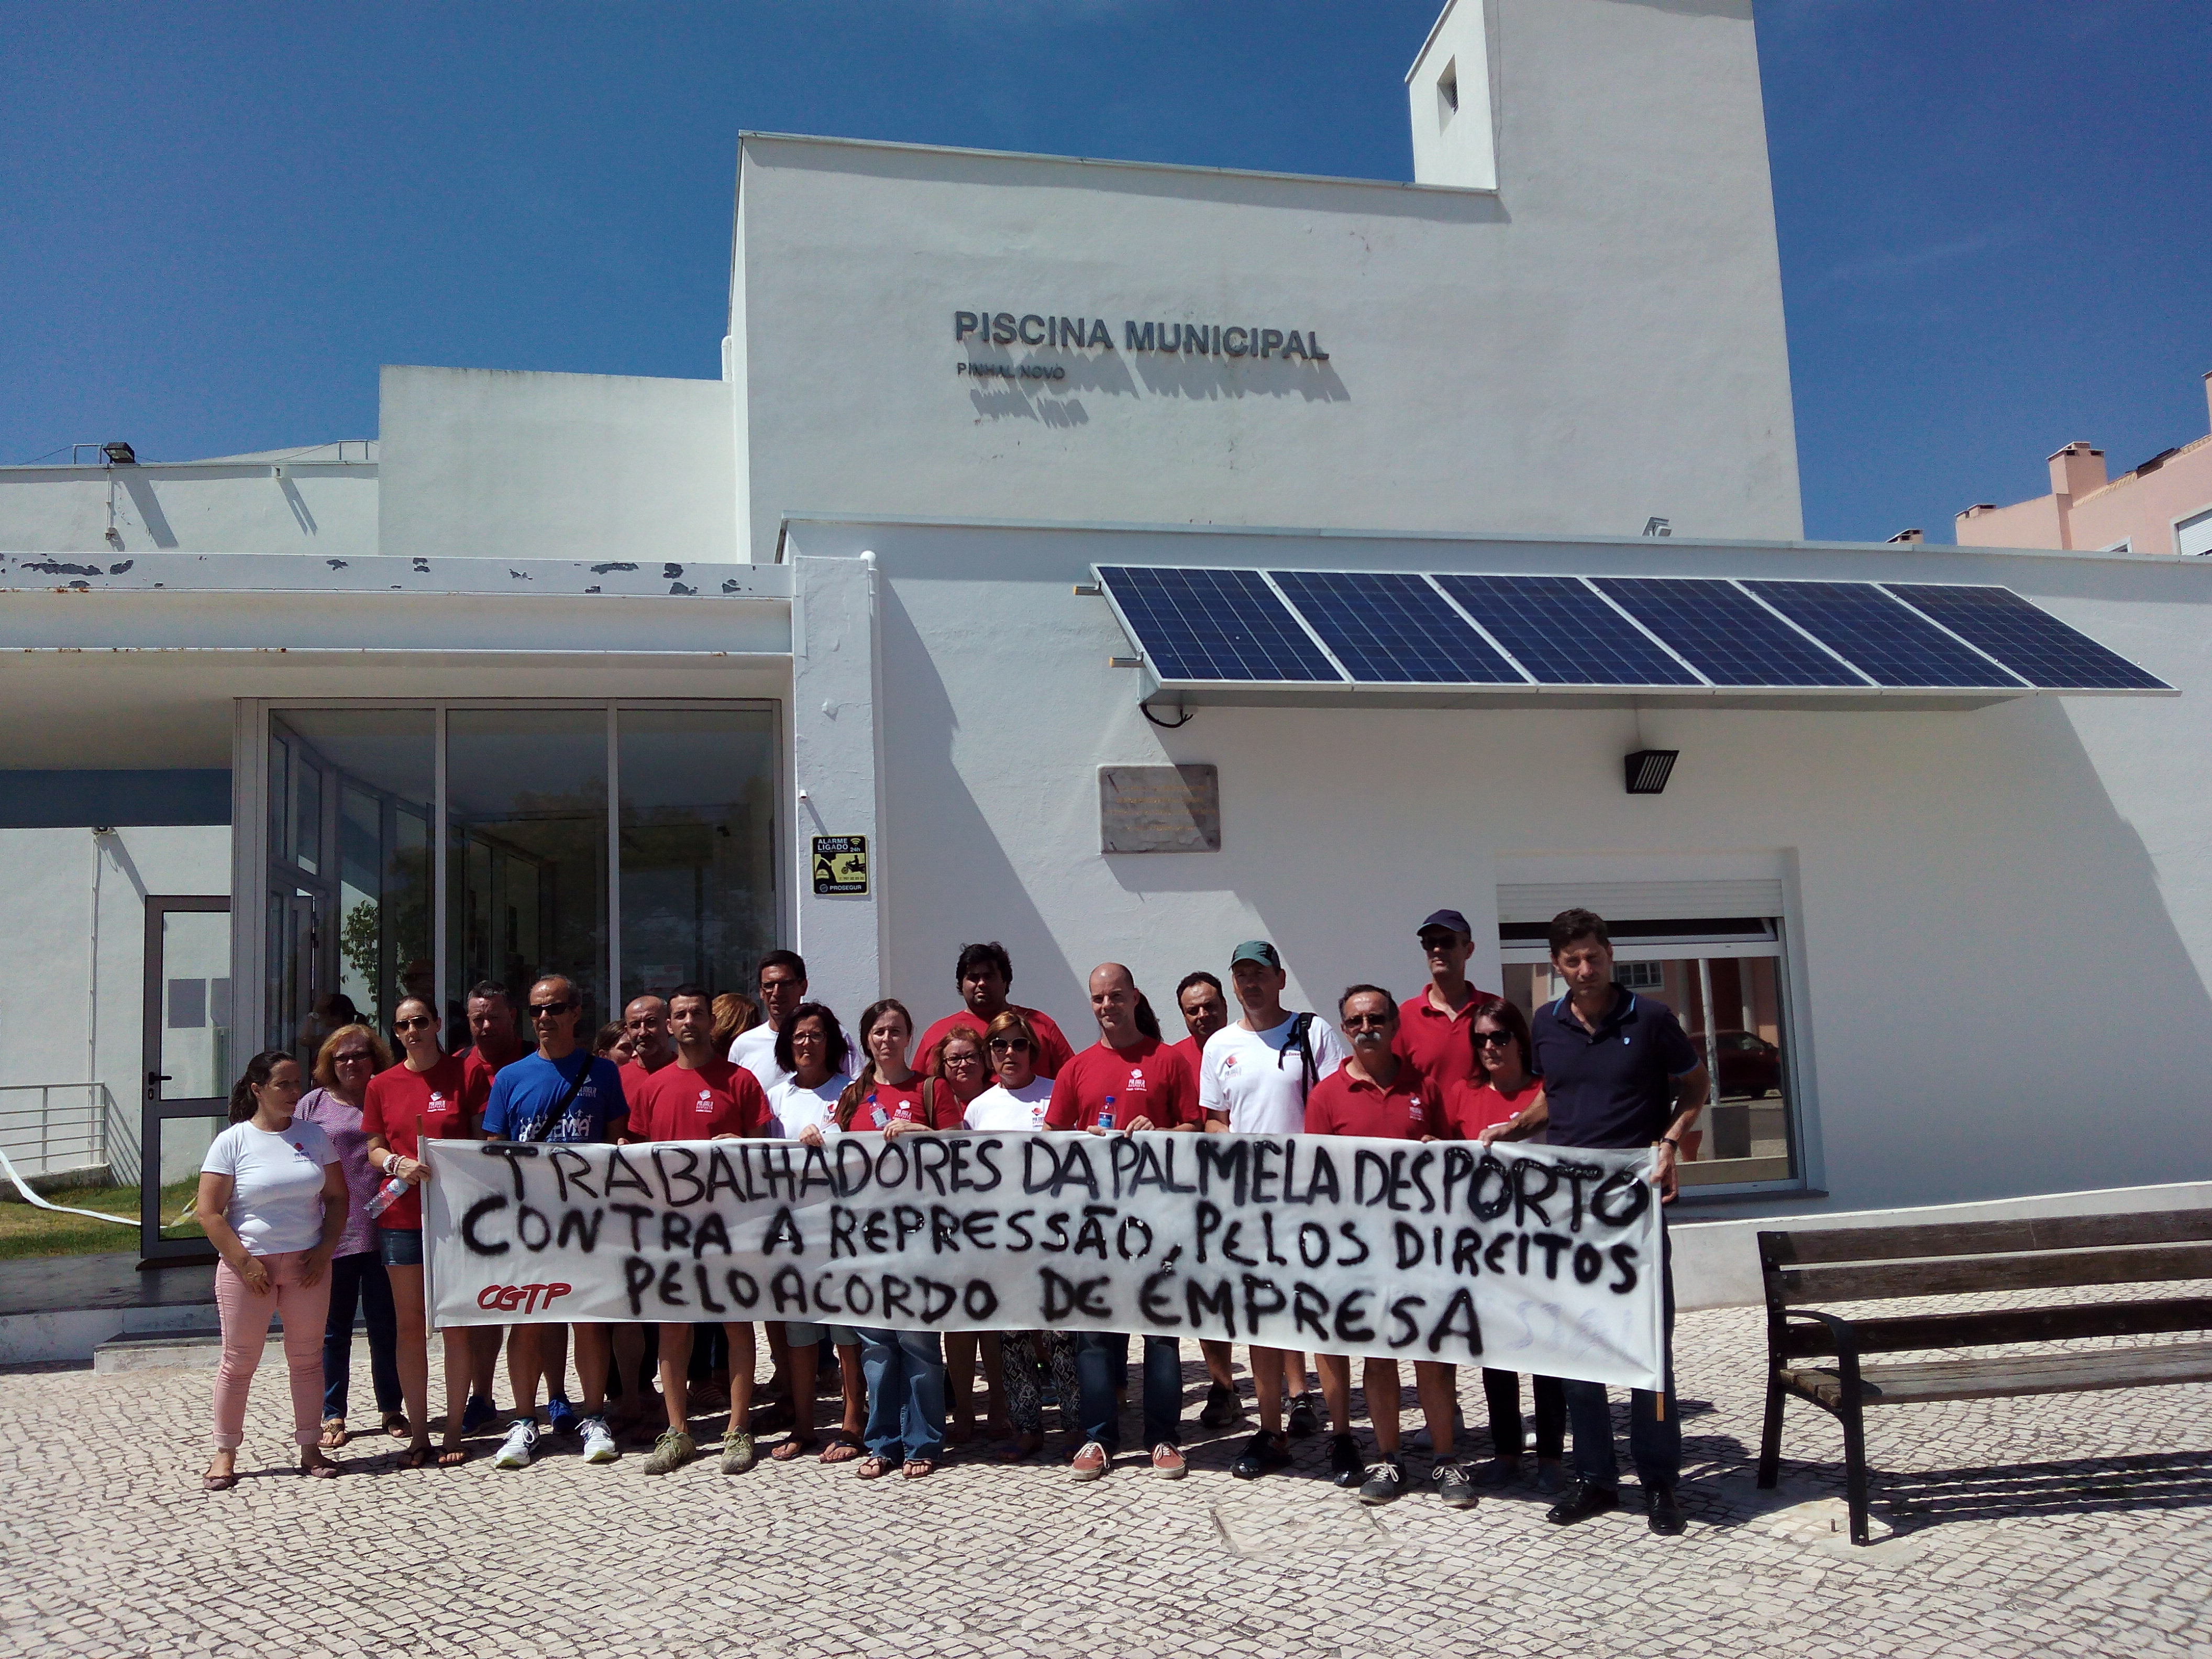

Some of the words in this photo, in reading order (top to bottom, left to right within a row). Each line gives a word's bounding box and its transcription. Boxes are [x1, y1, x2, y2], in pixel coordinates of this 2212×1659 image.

[955, 311, 1114, 350] PISCINA
[1125, 319, 1330, 360] MUNICIPAL
[957, 362, 1016, 379] PINHAL
[1020, 365, 1066, 380] NOVO
[481, 1137, 1003, 1207] TRABALHADORES
[1023, 1137, 1100, 1200] DA
[1110, 1136, 1340, 1206] PALMELA
[1355, 1146, 1651, 1232] DESPORTO
[461, 1195, 734, 1259] CONTRA
[762, 1207, 804, 1255] A
[1196, 1200, 1370, 1269] PELOS
[1395, 1221, 1639, 1295] DIREITOS
[477, 1282, 573, 1314] CGTP
[625, 1257, 760, 1315] PELO
[769, 1263, 999, 1324] ACORDO
[1038, 1265, 1113, 1321] DE
